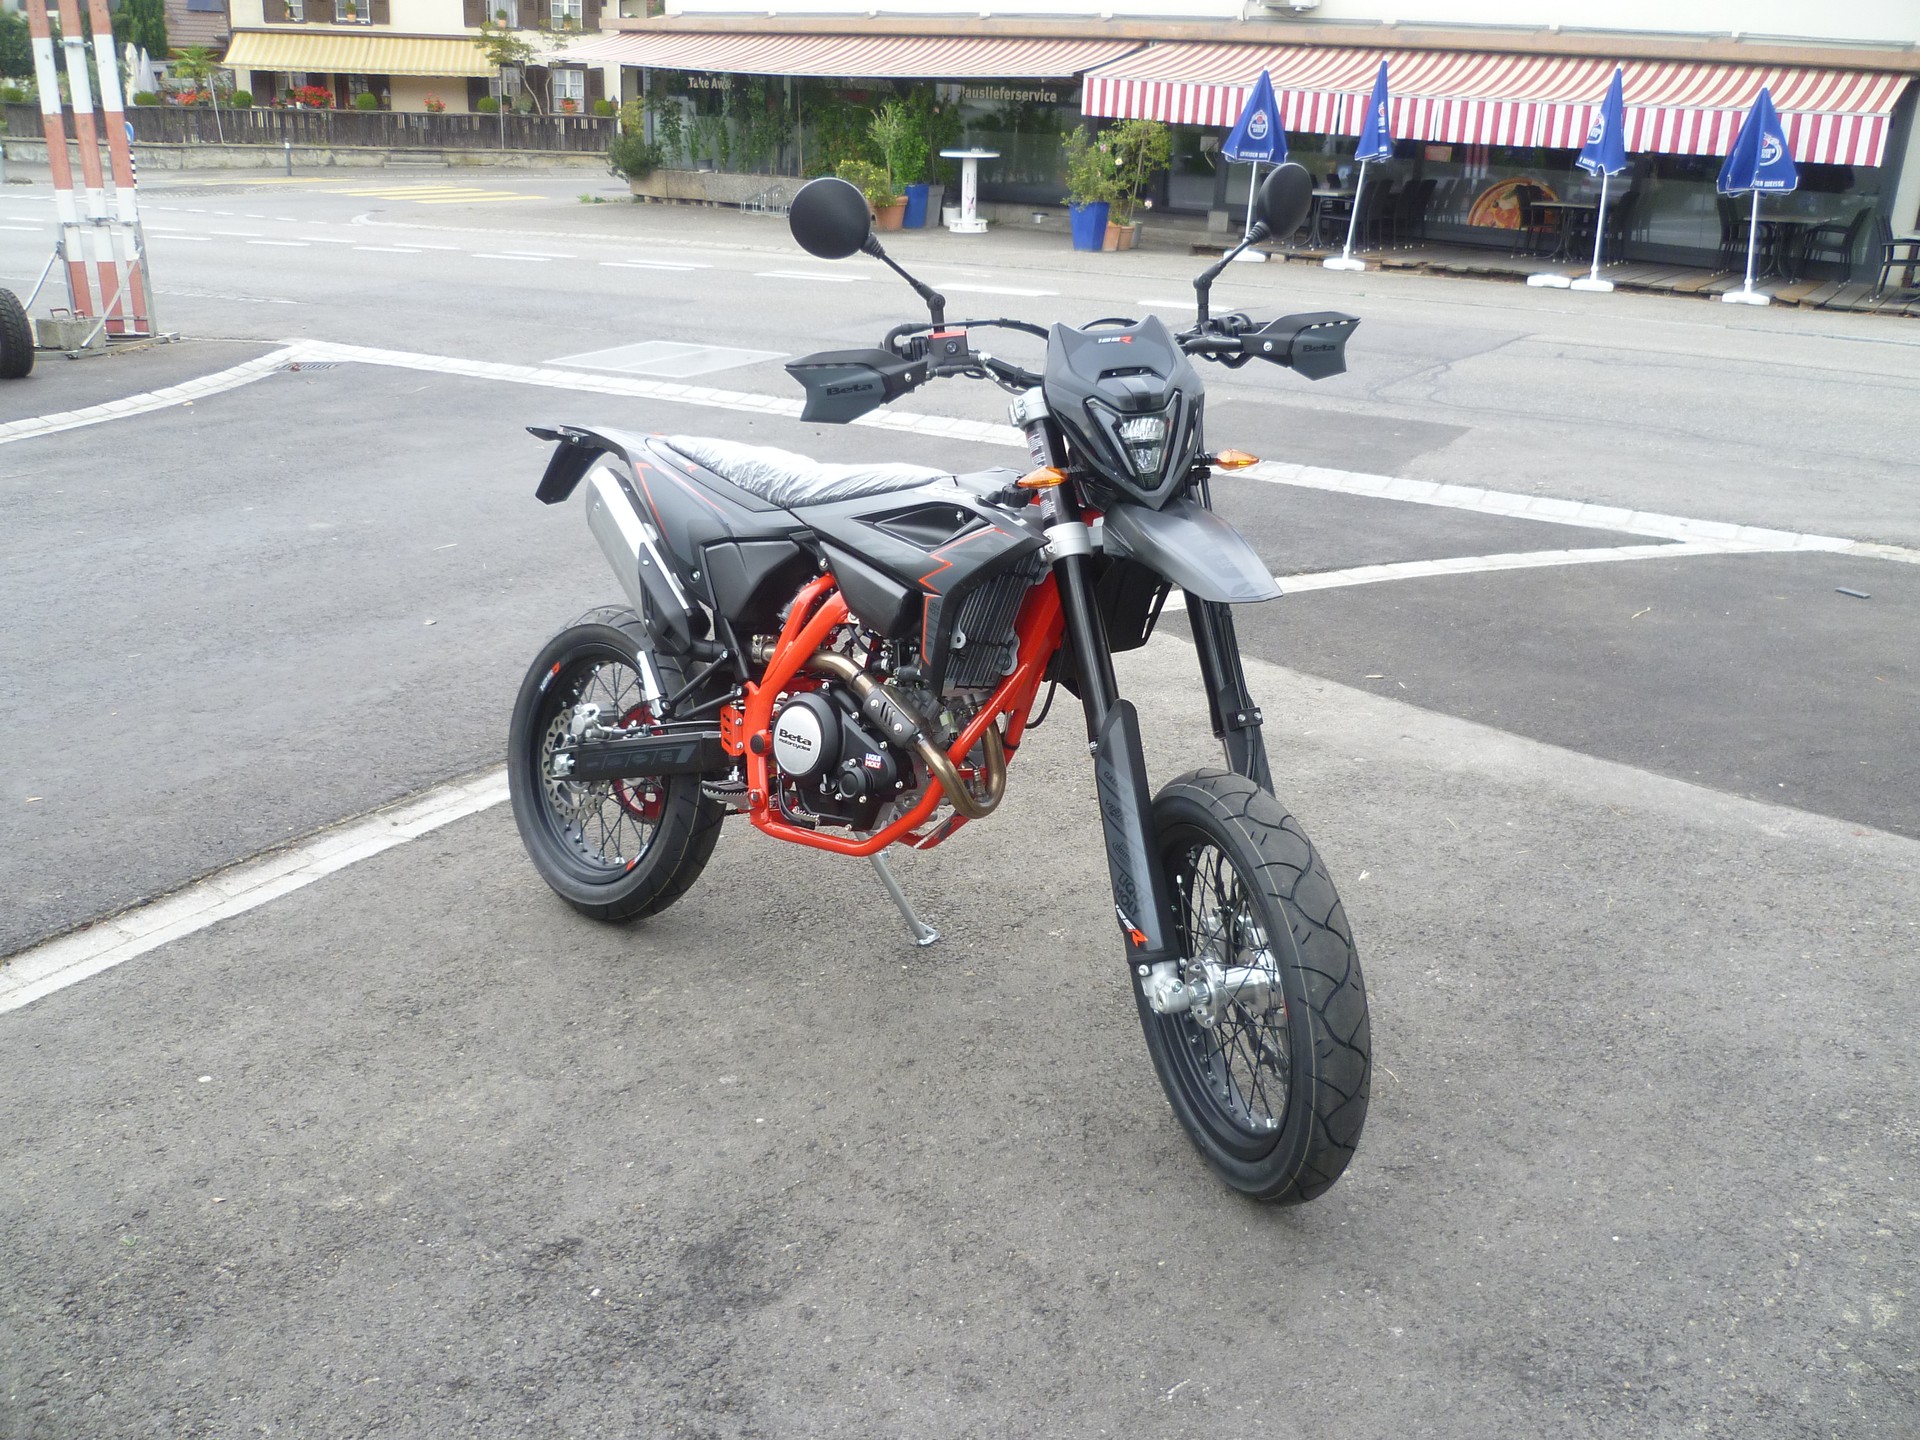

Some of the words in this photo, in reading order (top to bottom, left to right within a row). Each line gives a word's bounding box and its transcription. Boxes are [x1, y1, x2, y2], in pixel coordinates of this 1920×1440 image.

[688, 76, 710, 89] Take
[711, 77, 735, 90] Awa
[1302, 344, 1336, 353] Beta
[826, 383, 873, 396] Beta
[779, 728, 812, 746] Beta
[1114, 883, 1141, 917] MOLY
